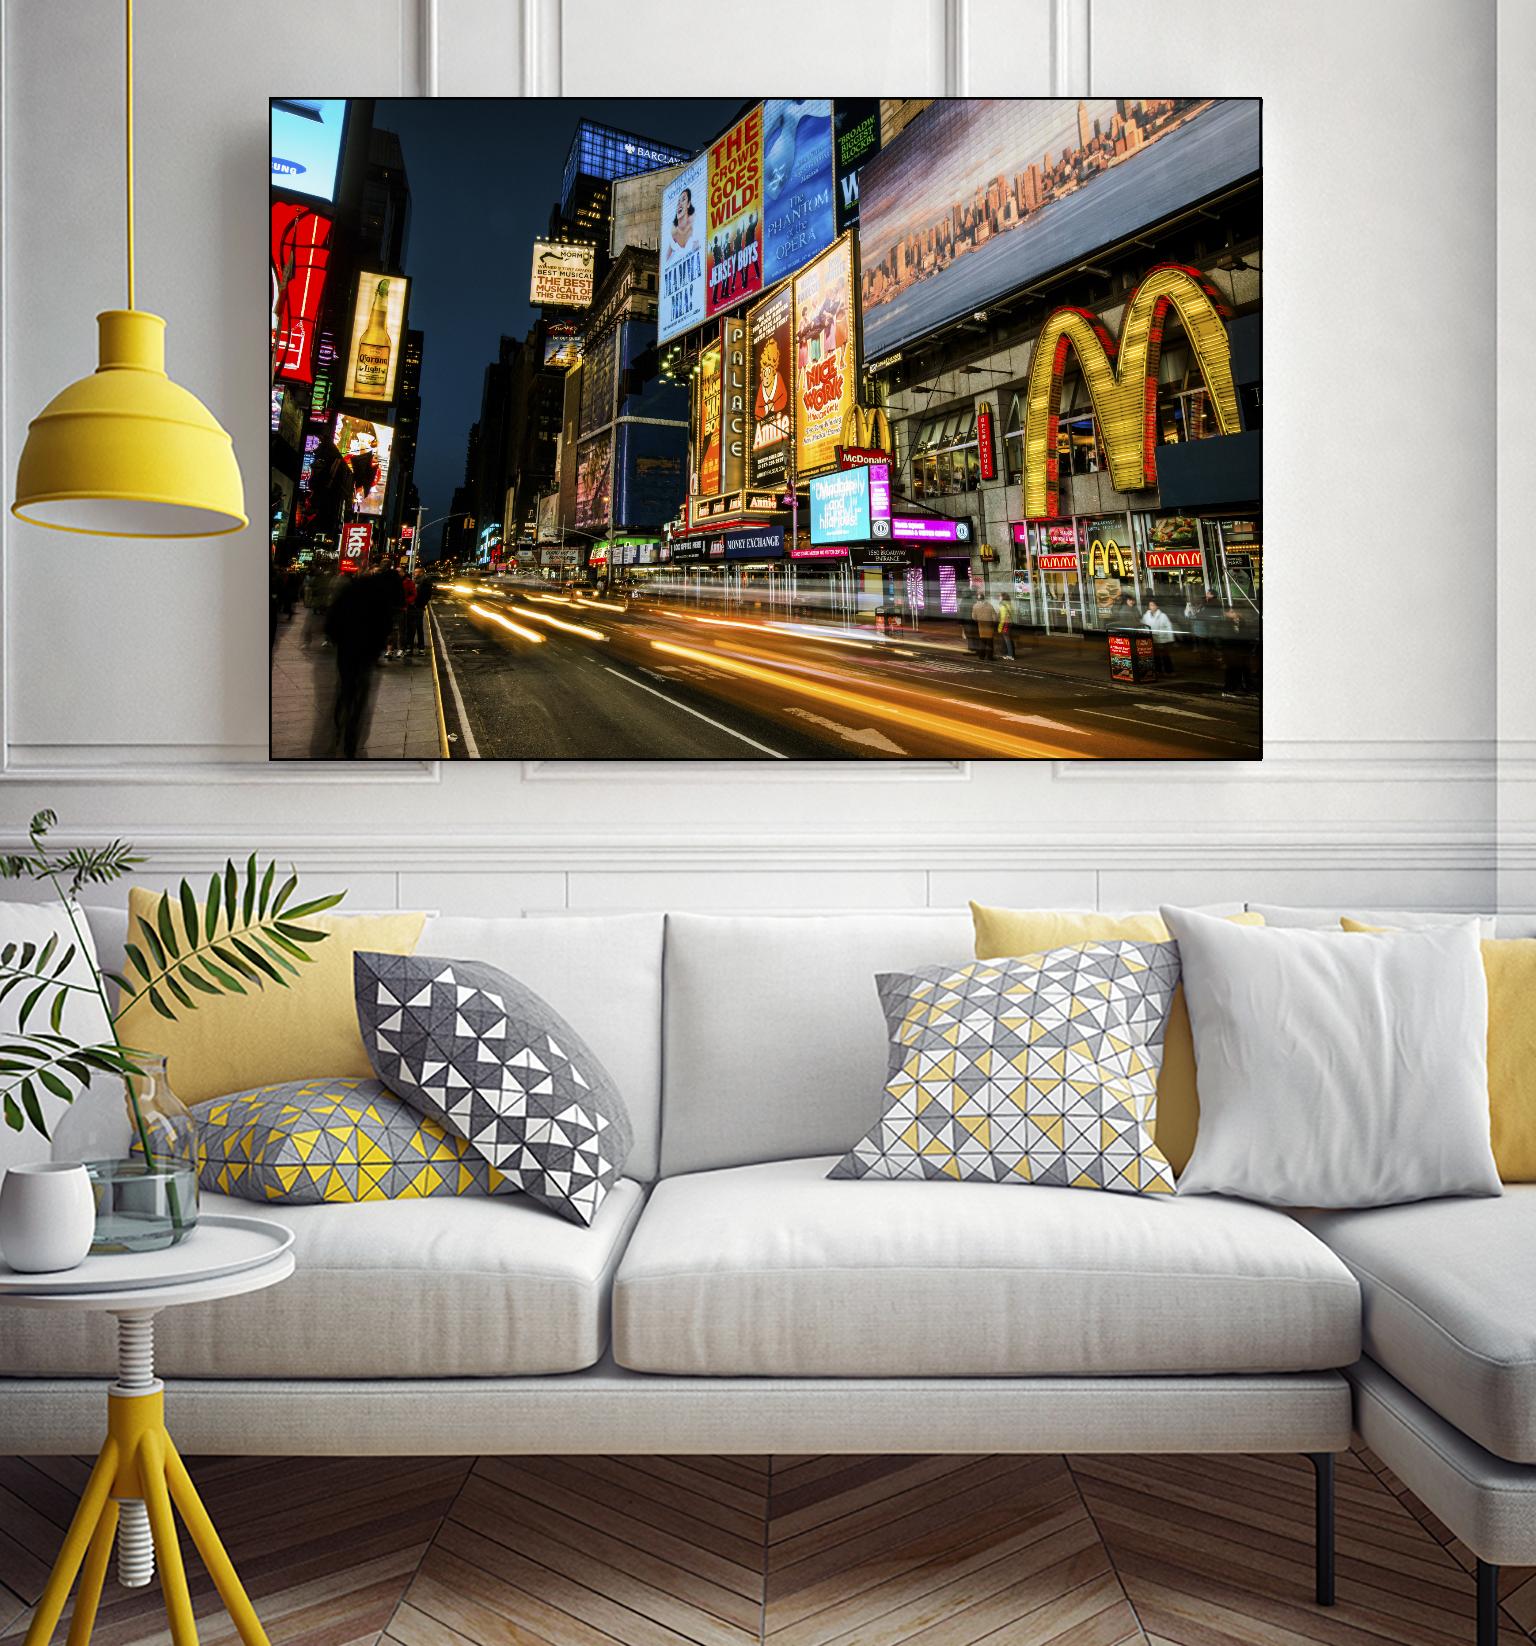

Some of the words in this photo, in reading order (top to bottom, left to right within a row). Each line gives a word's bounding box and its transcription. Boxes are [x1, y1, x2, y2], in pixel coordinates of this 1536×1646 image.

[711, 111, 759, 170] THE
[841, 125, 873, 153] BIGGEST
[272, 162, 297, 175] UNG
[711, 141, 759, 187] CROWD
[711, 158, 759, 208] GOES
[711, 177, 760, 229] WILD!
[768, 188, 829, 237] PHANTOM
[560, 251, 594, 260] MORMN
[776, 228, 817, 260] OPERA
[559, 271, 594, 280] MUSICAL
[664, 251, 701, 298] MAMMA
[709, 254, 736, 287] JERSEY
[738, 241, 758, 271] BOYS
[536, 285, 578, 295] MUSICAL
[556, 293, 592, 301] CENTURY
[564, 278, 593, 289] BEST
[671, 284, 693, 321] MIA!
[806, 355, 838, 390] NICE
[731, 328, 743, 457] PALACE
[803, 376, 844, 411] WORK
[752, 411, 789, 450] Annie
[843, 453, 893, 465] McDonald's
[750, 494, 777, 509] Annie
[346, 526, 367, 558] tkts
[727, 538, 746, 550] MONEY
[746, 535, 780, 549] EXCHANGE
